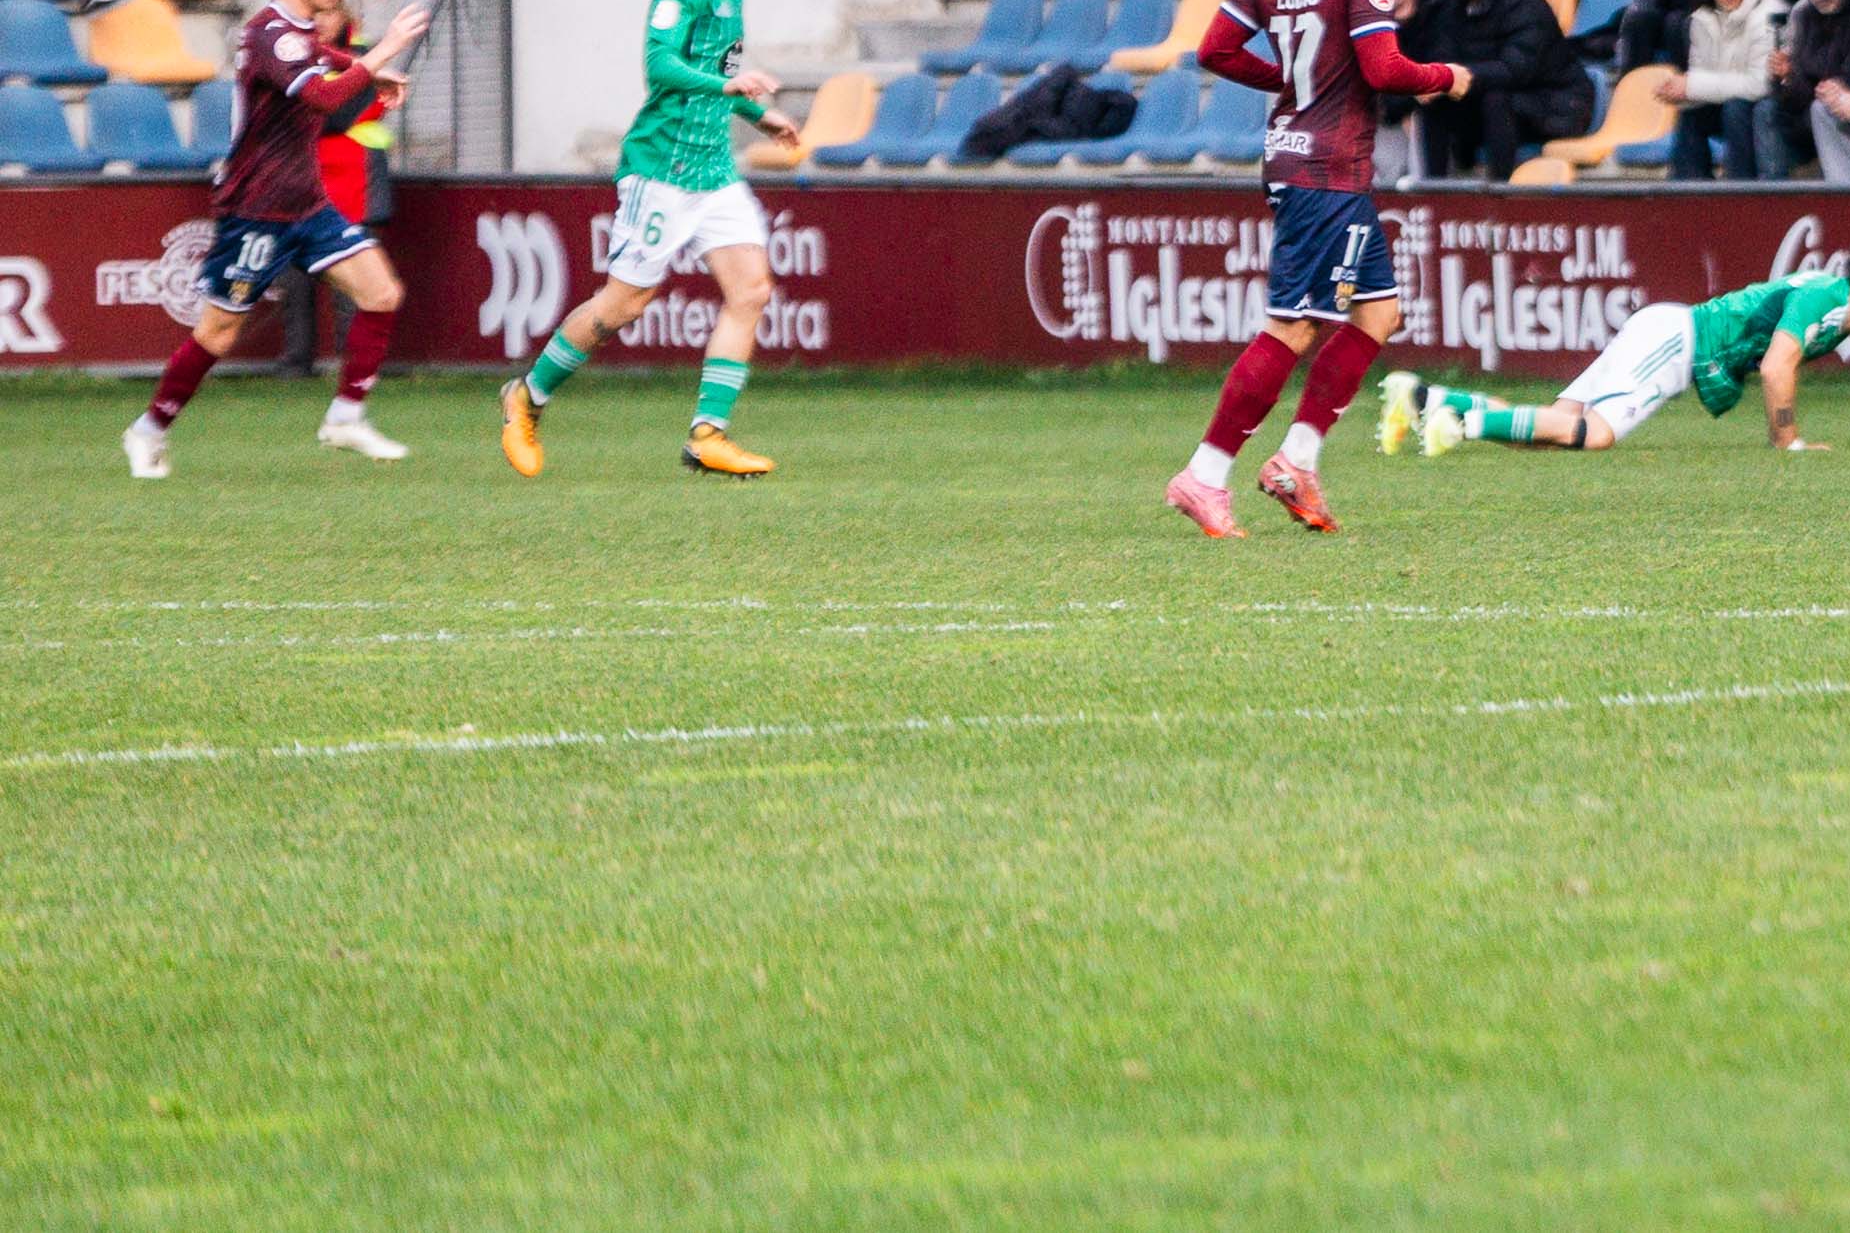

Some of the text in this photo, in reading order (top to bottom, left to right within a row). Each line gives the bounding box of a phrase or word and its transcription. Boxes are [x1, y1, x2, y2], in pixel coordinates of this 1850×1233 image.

[1268, 11, 1326, 112] 17
[642, 211, 665, 246] 6
[1106, 216, 1235, 245] MONTAJES
[236, 230, 276, 271] 10
[1439, 220, 1635, 283] MONTAJES J.M.
